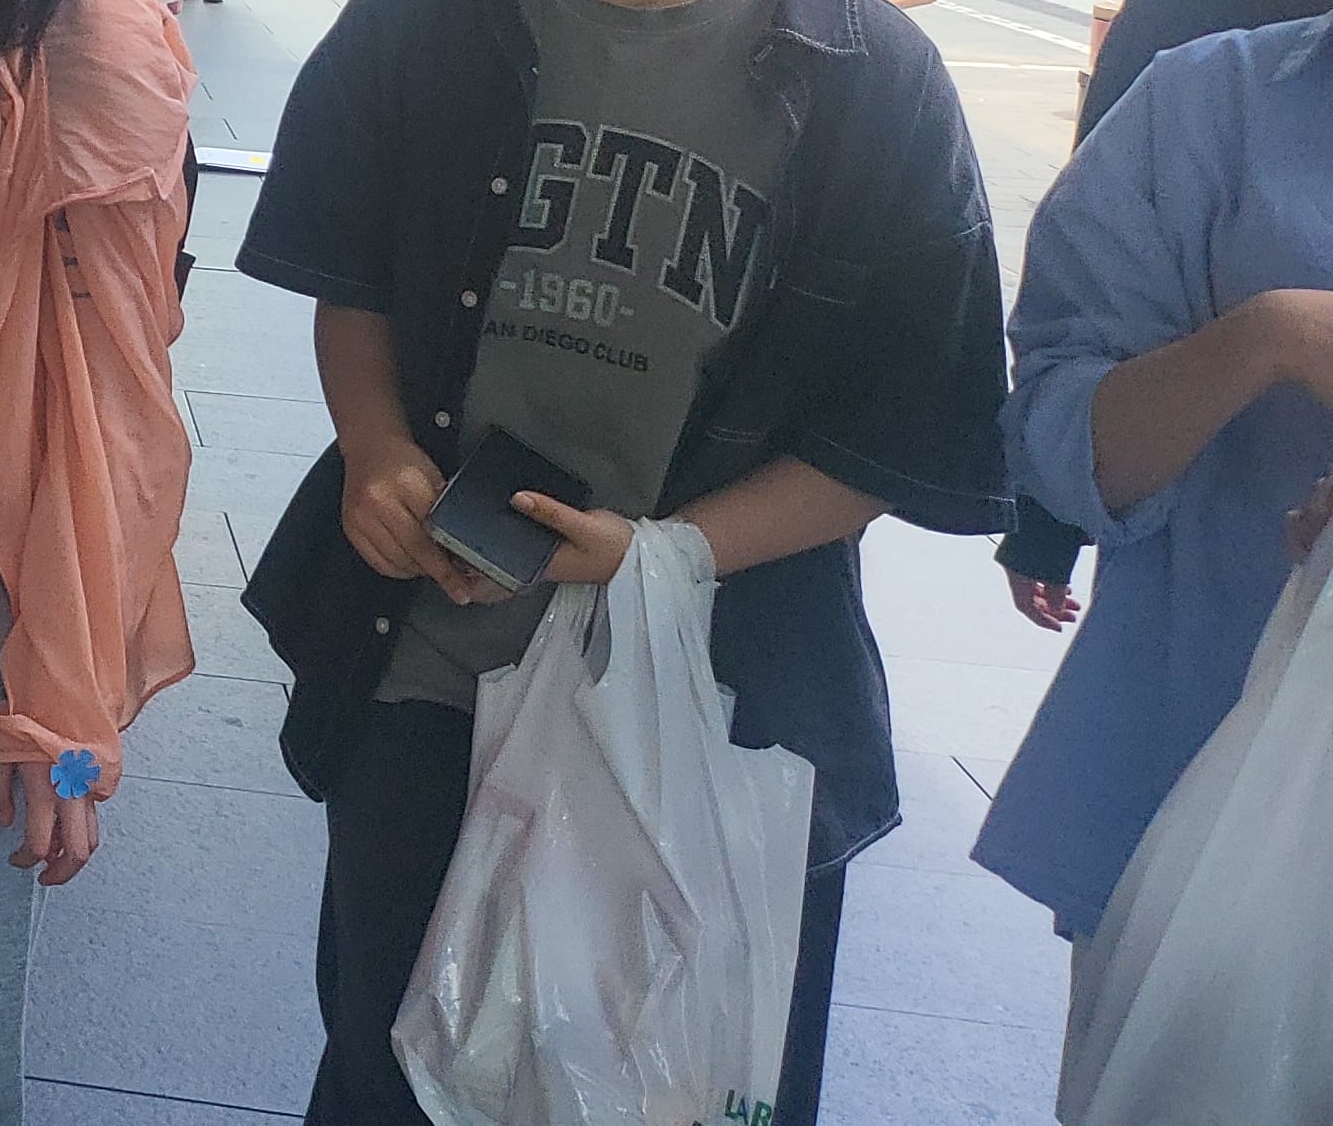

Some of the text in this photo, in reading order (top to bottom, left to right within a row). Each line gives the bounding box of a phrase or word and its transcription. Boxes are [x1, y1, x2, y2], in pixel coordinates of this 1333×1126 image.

[483, 319, 650, 373] AN DIEGO CLUB
[724, 1088, 773, 1126] LAR
